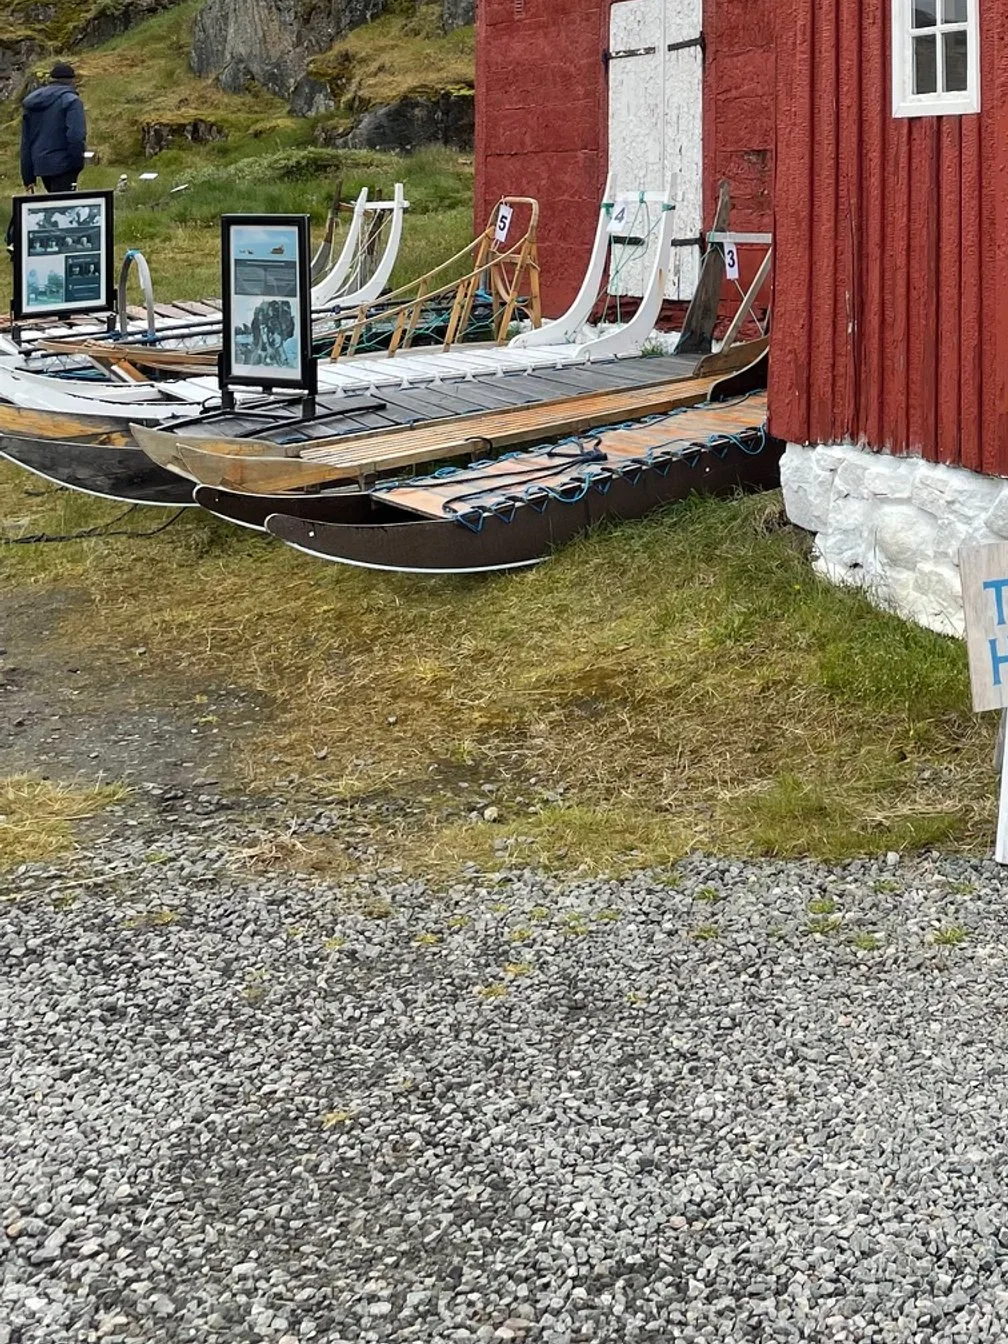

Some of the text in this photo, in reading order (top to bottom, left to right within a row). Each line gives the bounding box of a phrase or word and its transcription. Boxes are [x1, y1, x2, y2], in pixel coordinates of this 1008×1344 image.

[498, 214, 508, 232] 5
[614, 207, 626, 224] 4
[727, 250, 736, 269] 3
